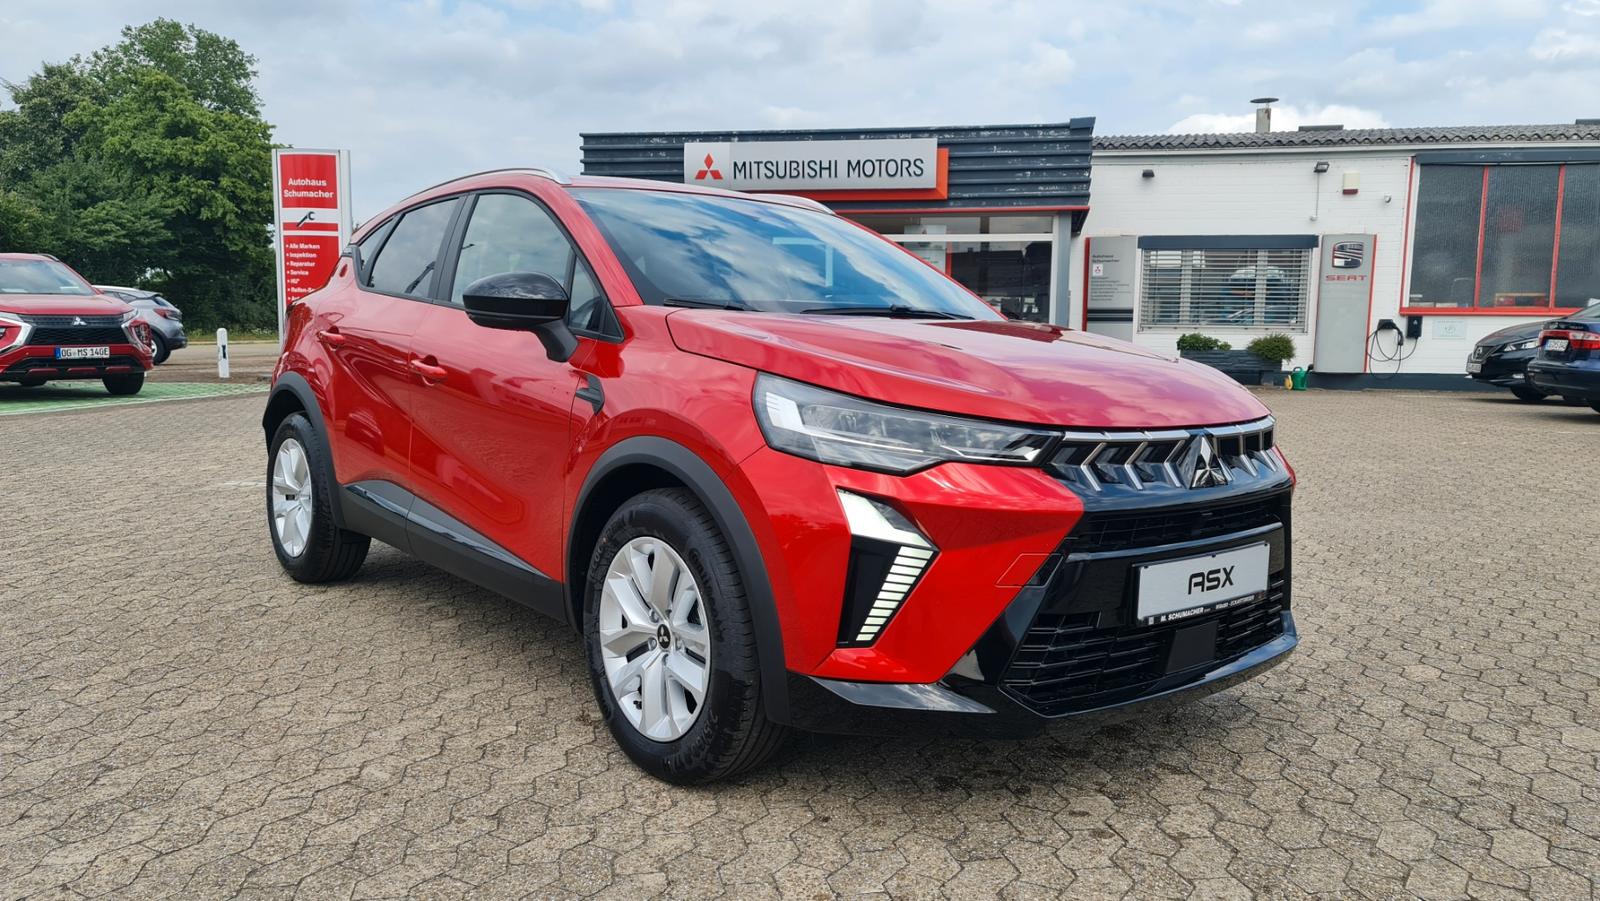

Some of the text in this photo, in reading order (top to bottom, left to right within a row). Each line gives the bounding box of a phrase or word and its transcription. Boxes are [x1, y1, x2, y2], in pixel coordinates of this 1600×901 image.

[733, 158, 924, 180] MITSUBISHI MOTORS
[288, 178, 327, 187] Autohaus
[283, 189, 335, 198] Schumacher
[61, 349, 72, 357] OG
[77, 348, 88, 357] MS
[1188, 565, 1236, 595] ASX
[1168, 607, 1204, 621] SCHUMACHER
